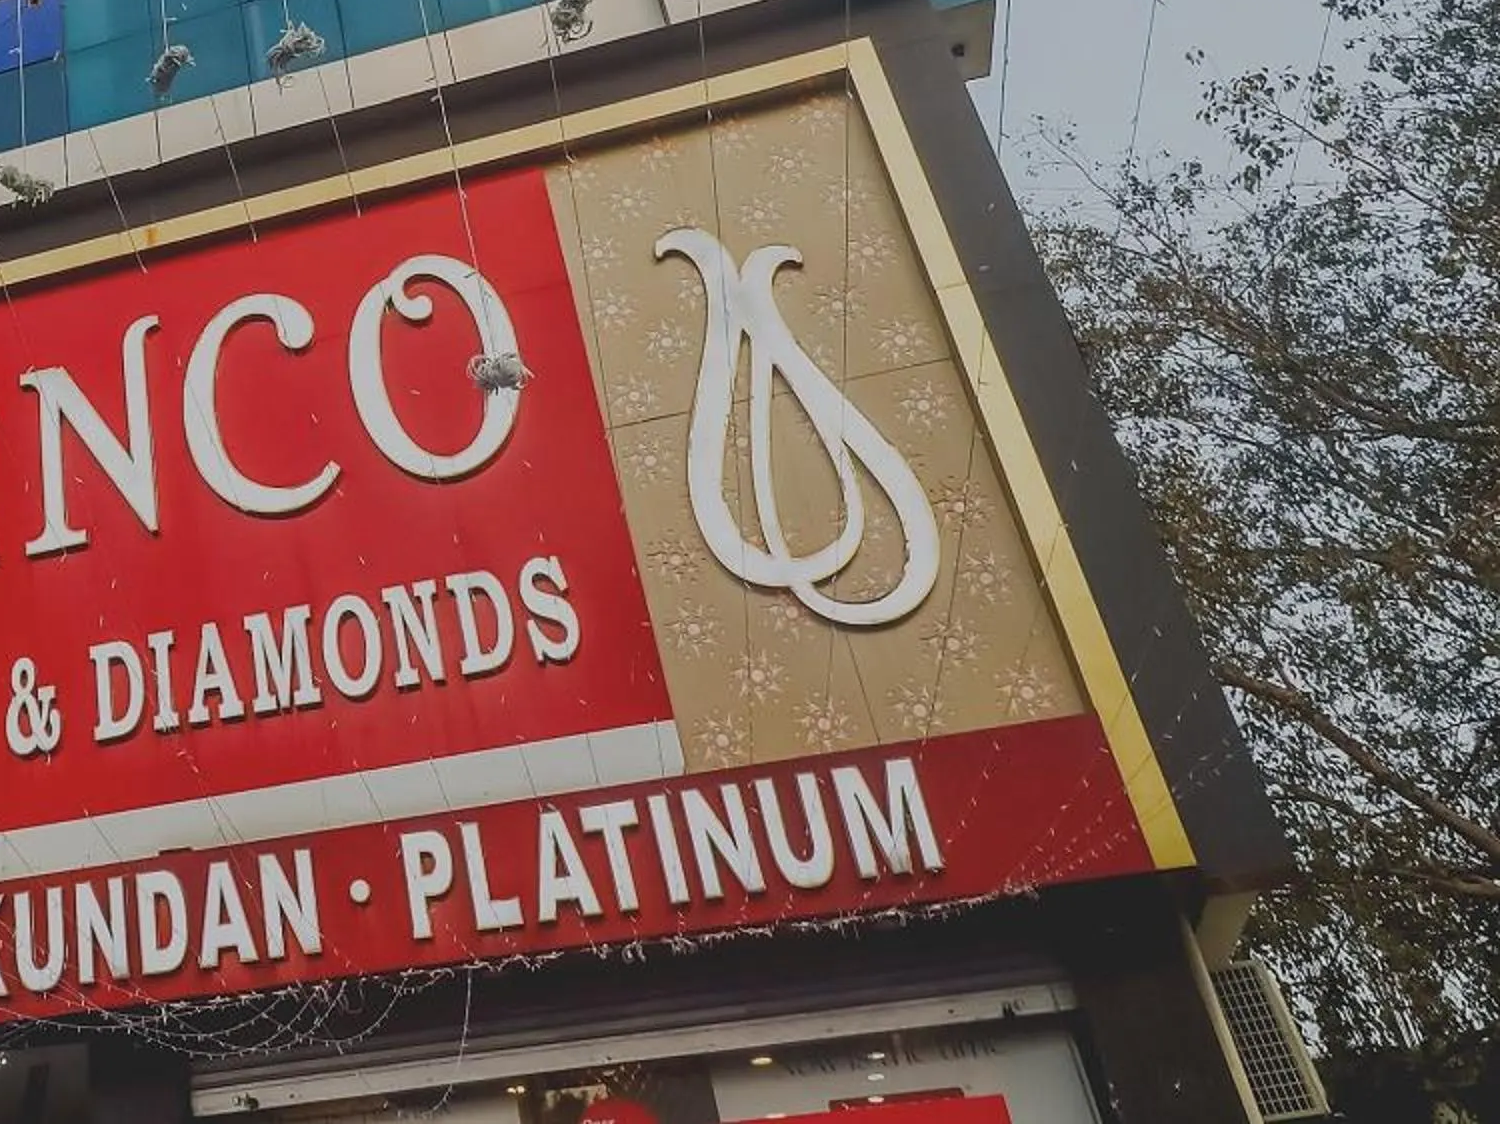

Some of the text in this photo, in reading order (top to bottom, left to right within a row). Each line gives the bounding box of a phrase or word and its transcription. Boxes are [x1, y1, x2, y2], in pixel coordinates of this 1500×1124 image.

[5, 656, 62, 757] &
[88, 556, 581, 742] DIAMONDS
[400, 758, 944, 940] PLATINUM
